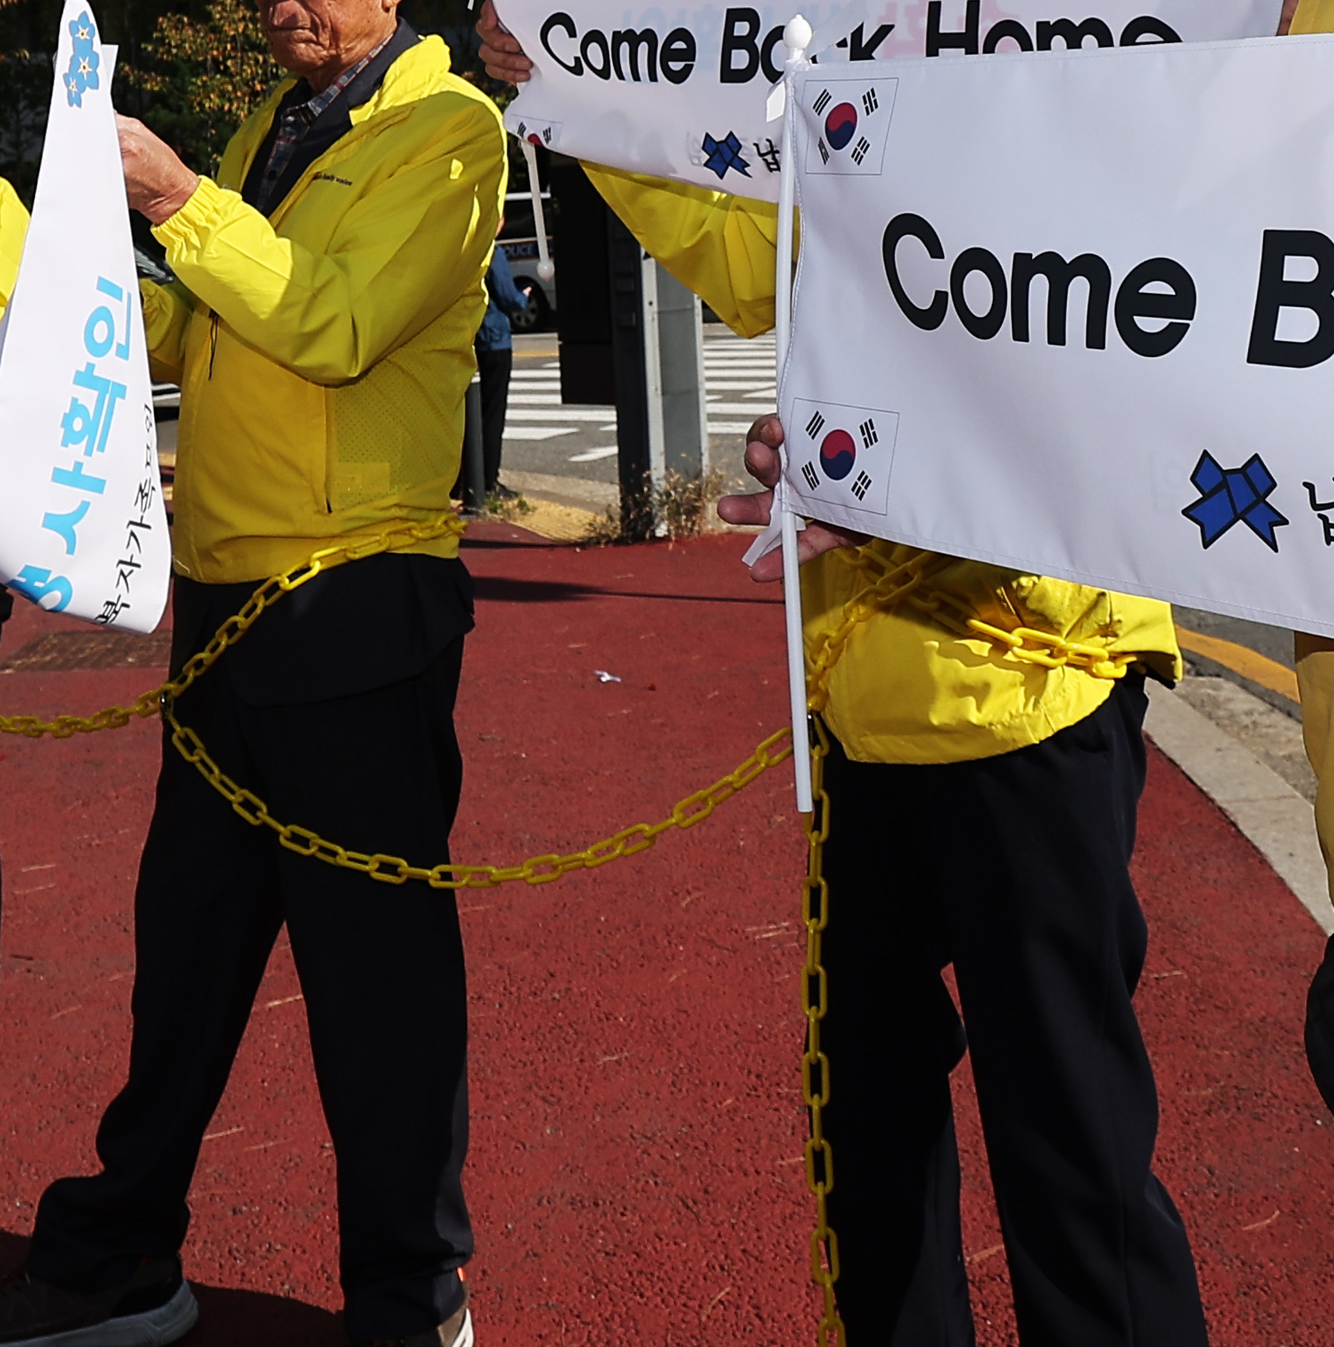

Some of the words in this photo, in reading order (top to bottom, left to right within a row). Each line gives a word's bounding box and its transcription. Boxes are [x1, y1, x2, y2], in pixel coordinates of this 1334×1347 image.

[539, 11, 697, 85] Come
[719, 7, 896, 86] Bak
[882, 212, 1197, 358] Come
